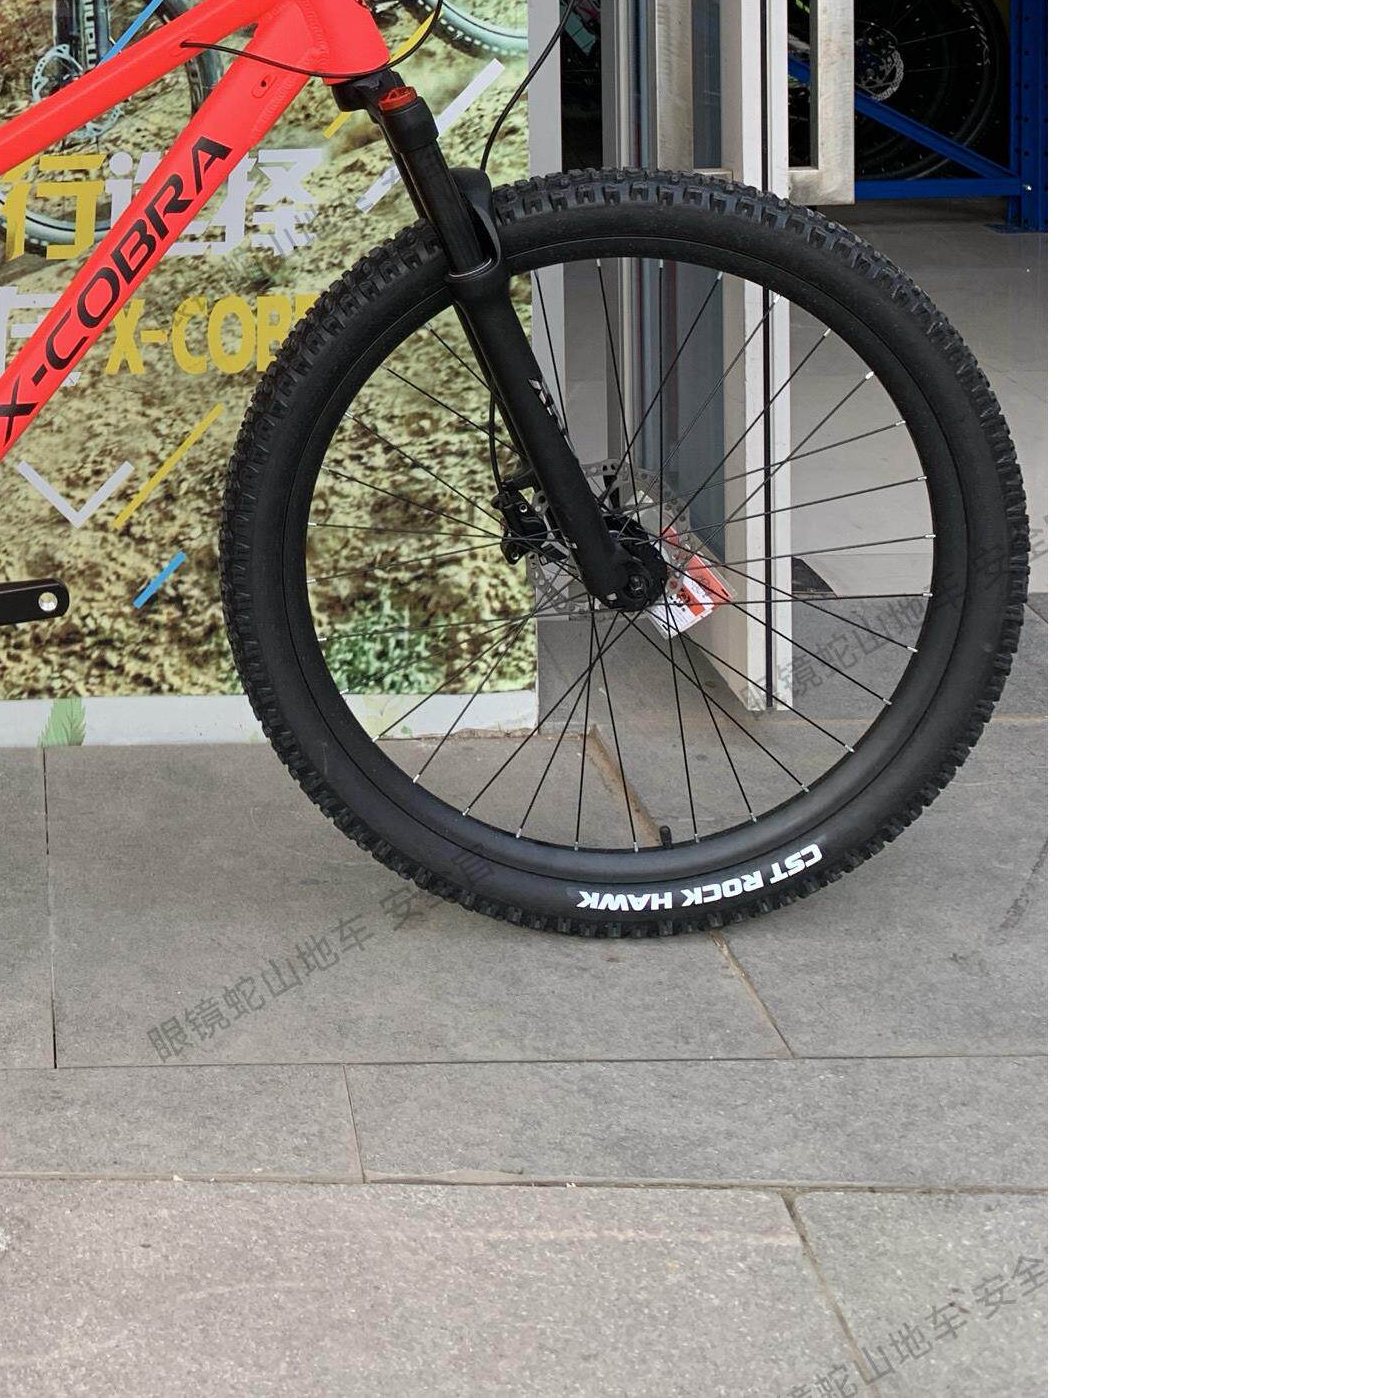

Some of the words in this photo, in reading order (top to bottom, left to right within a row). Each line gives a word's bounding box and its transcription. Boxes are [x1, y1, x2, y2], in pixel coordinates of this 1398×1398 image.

[769, 843, 824, 885] CST
[576, 891, 673, 912] HAWK
[681, 870, 764, 907] ROCK
